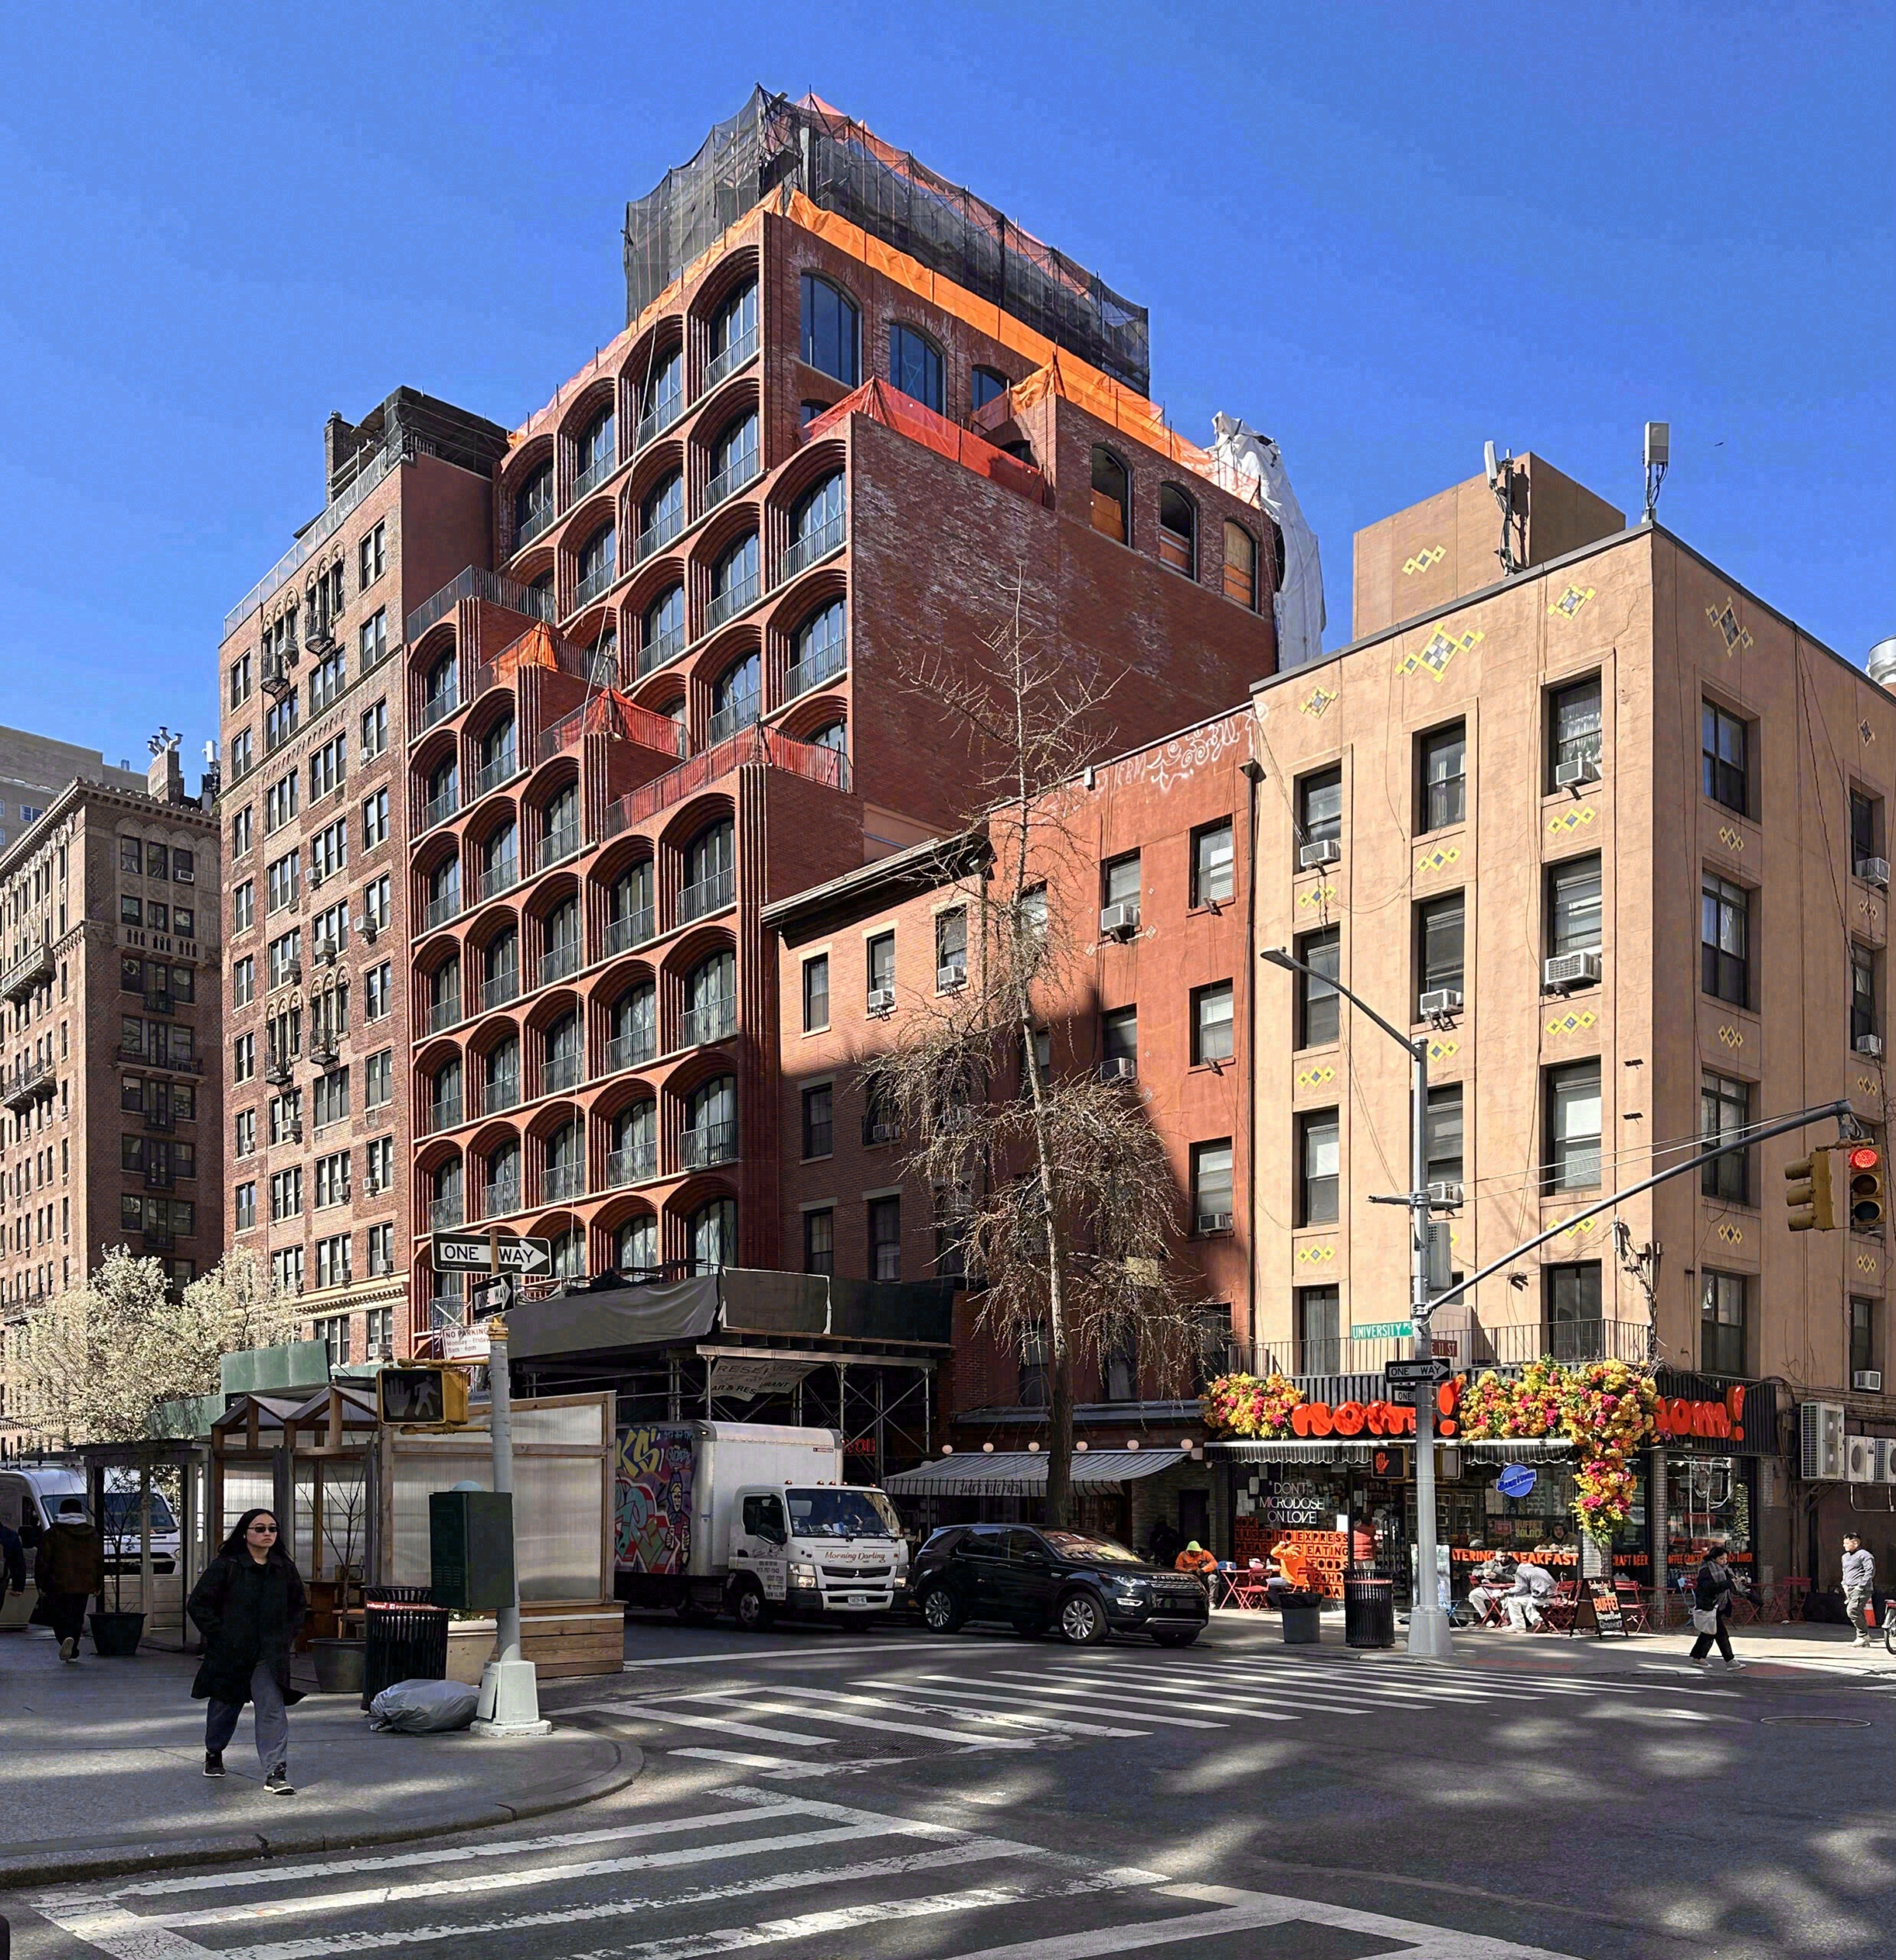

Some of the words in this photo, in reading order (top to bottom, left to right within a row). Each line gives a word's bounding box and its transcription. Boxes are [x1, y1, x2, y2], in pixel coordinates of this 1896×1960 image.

[444, 1245, 479, 1260] ONE
[499, 1248, 534, 1263] WAY
[478, 1291, 490, 1308] ONE
[494, 1285, 507, 1302] WAY
[458, 1327, 489, 1338] PARKING
[1352, 1323, 1401, 1339] UNIVERSITY
[1430, 1342, 1434, 1354] E
[1438, 1342, 1444, 1354] 11
[1447, 1343, 1455, 1356] ST
[1391, 1367, 1409, 1377] ONE
[1420, 1366, 1441, 1376] WAY
[1398, 1392, 1412, 1401] ONE
[1273, 1482, 1306, 1494] DON'T
[1260, 1496, 1325, 1510] MICRODOSE
[1267, 1511, 1284, 1522] ON
[1287, 1511, 1317, 1524] LOVE
[1279, 1531, 1292, 1540] TO
[1297, 1532, 1348, 1543] EXPRESS
[825, 1551, 857, 1561] Morning
[858, 1552, 885, 1561] Darling
[1307, 1545, 1348, 1557] EATING
[1512, 1552, 1579, 1566] EAKFAST
[1593, 1596, 1620, 1612] BUFFET
